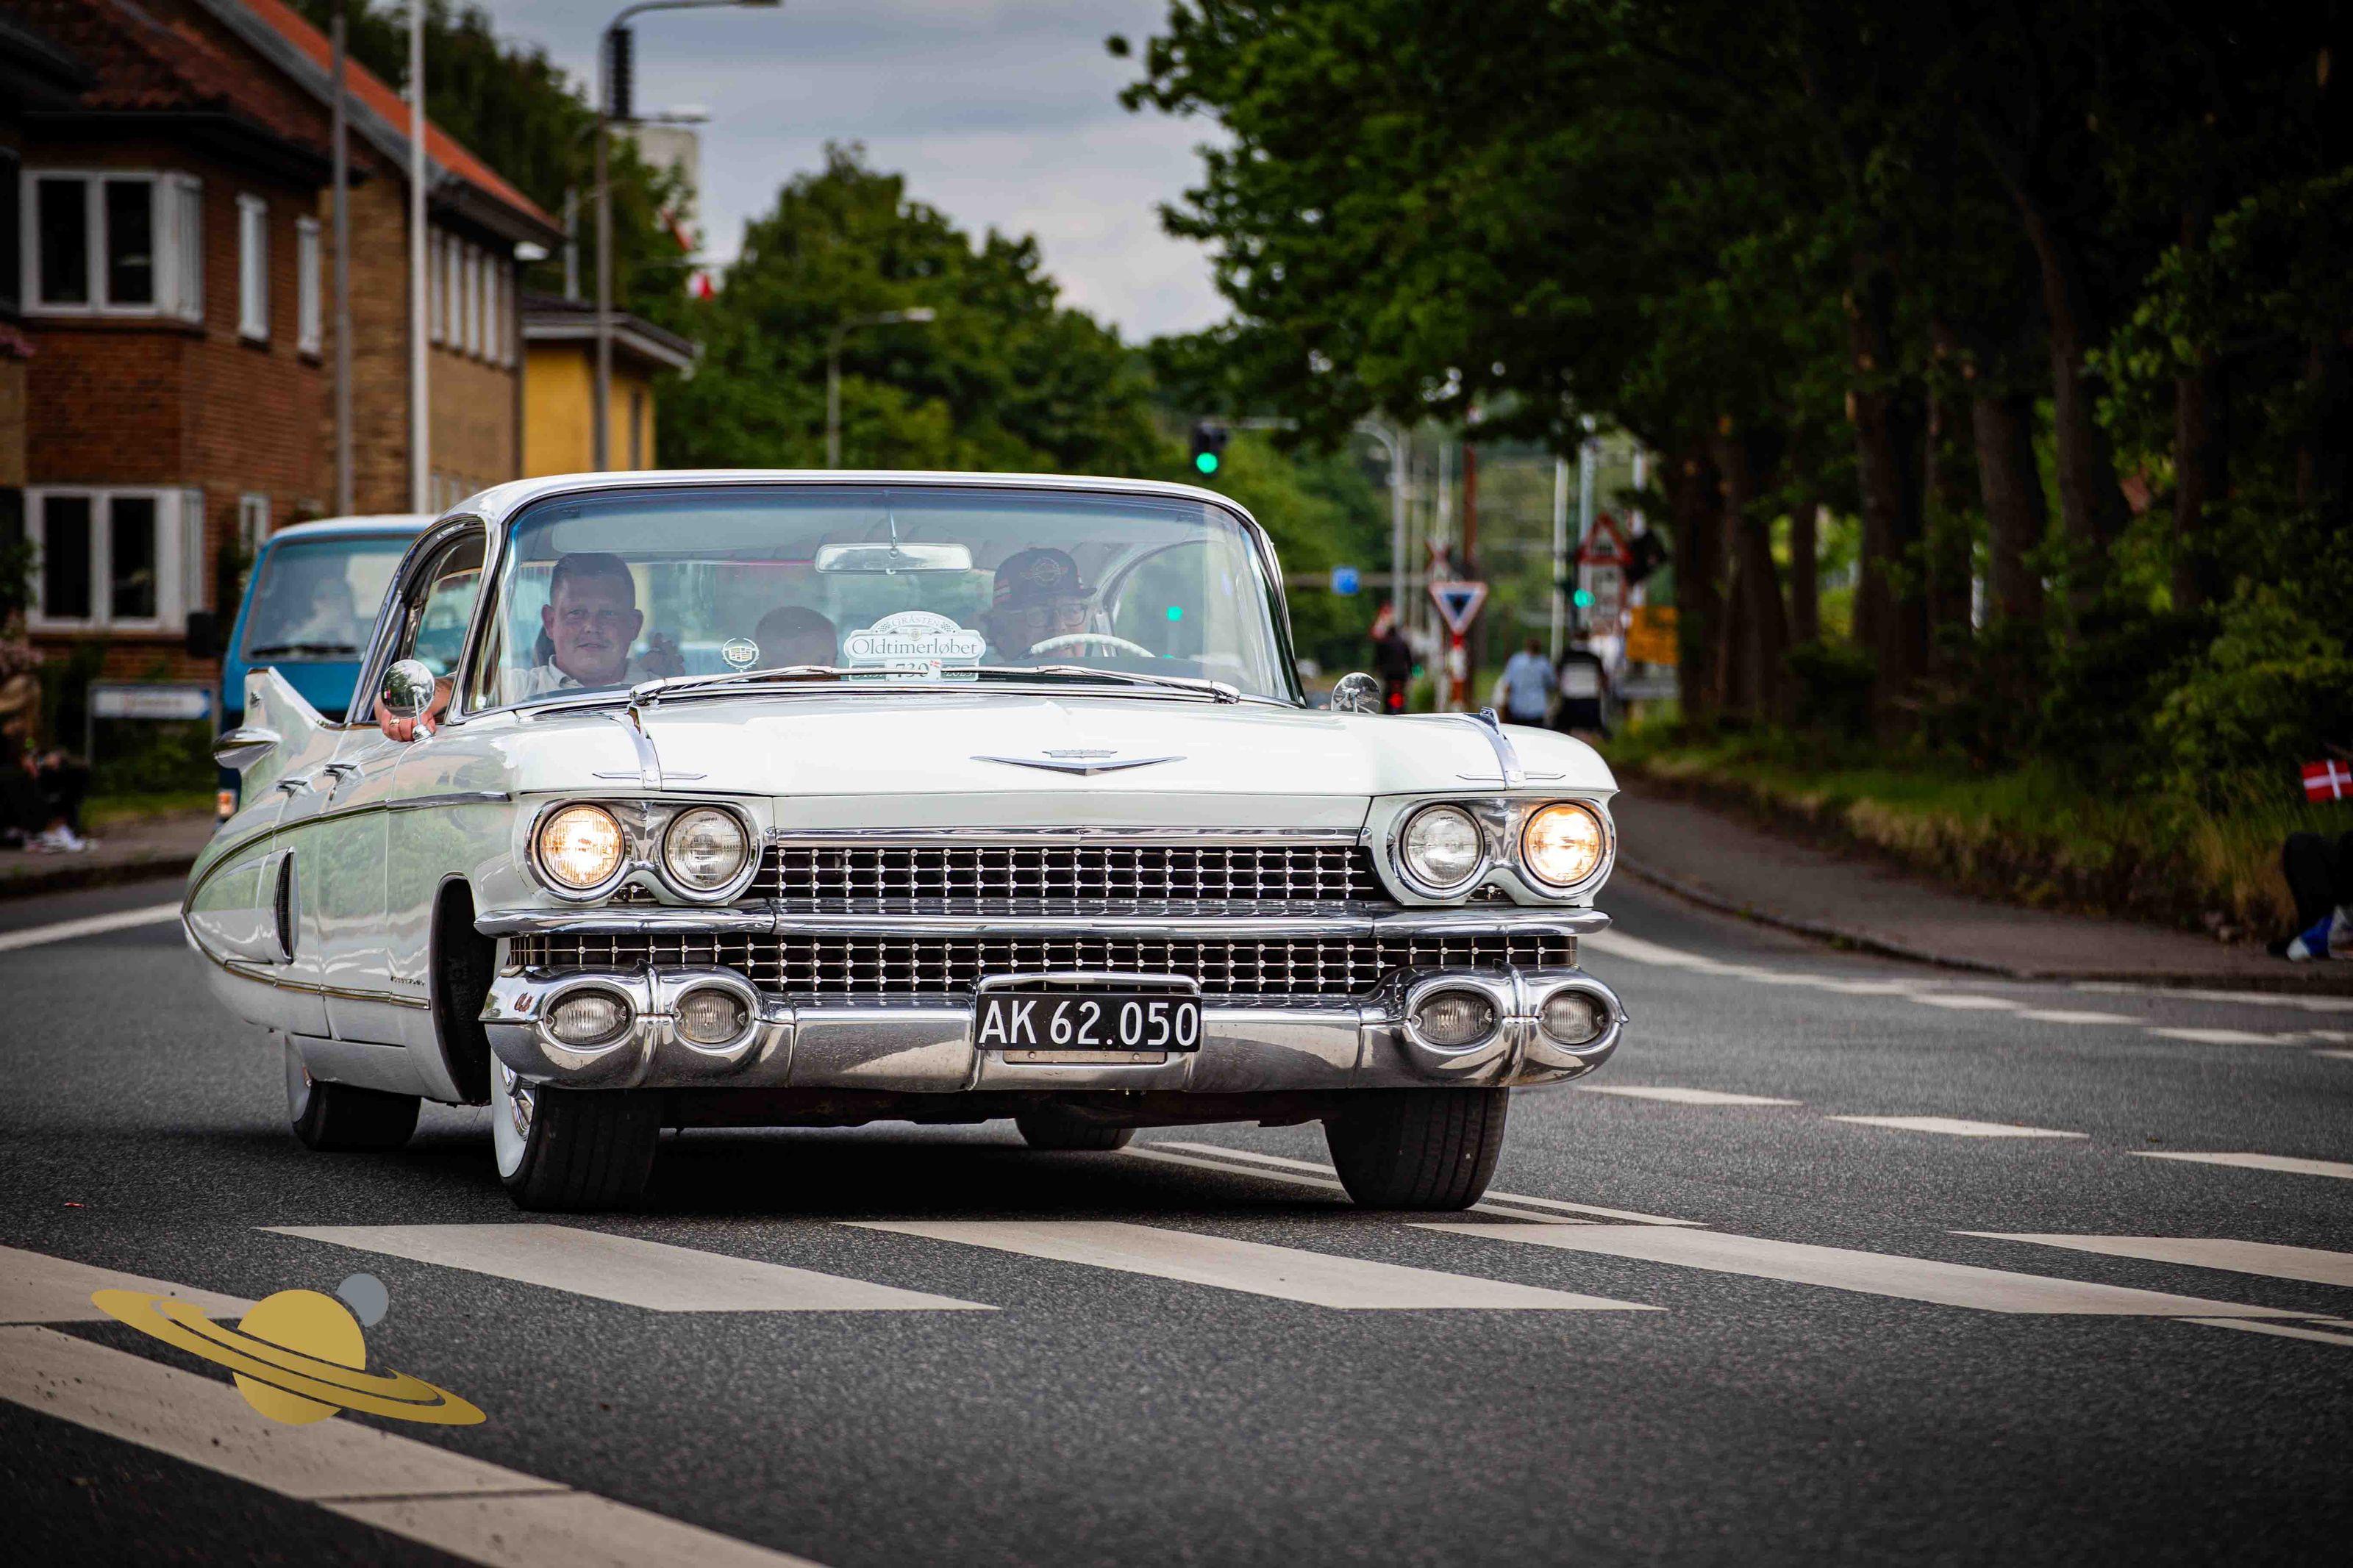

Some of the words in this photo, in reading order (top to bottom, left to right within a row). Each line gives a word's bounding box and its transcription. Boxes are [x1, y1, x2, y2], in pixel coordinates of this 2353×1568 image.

[892, 615, 940, 626] GRÅSTEN
[852, 638, 977, 655] Oldtimerløbet
[979, 1000, 1037, 1044] AK
[1050, 1000, 1199, 1046] 62.050
